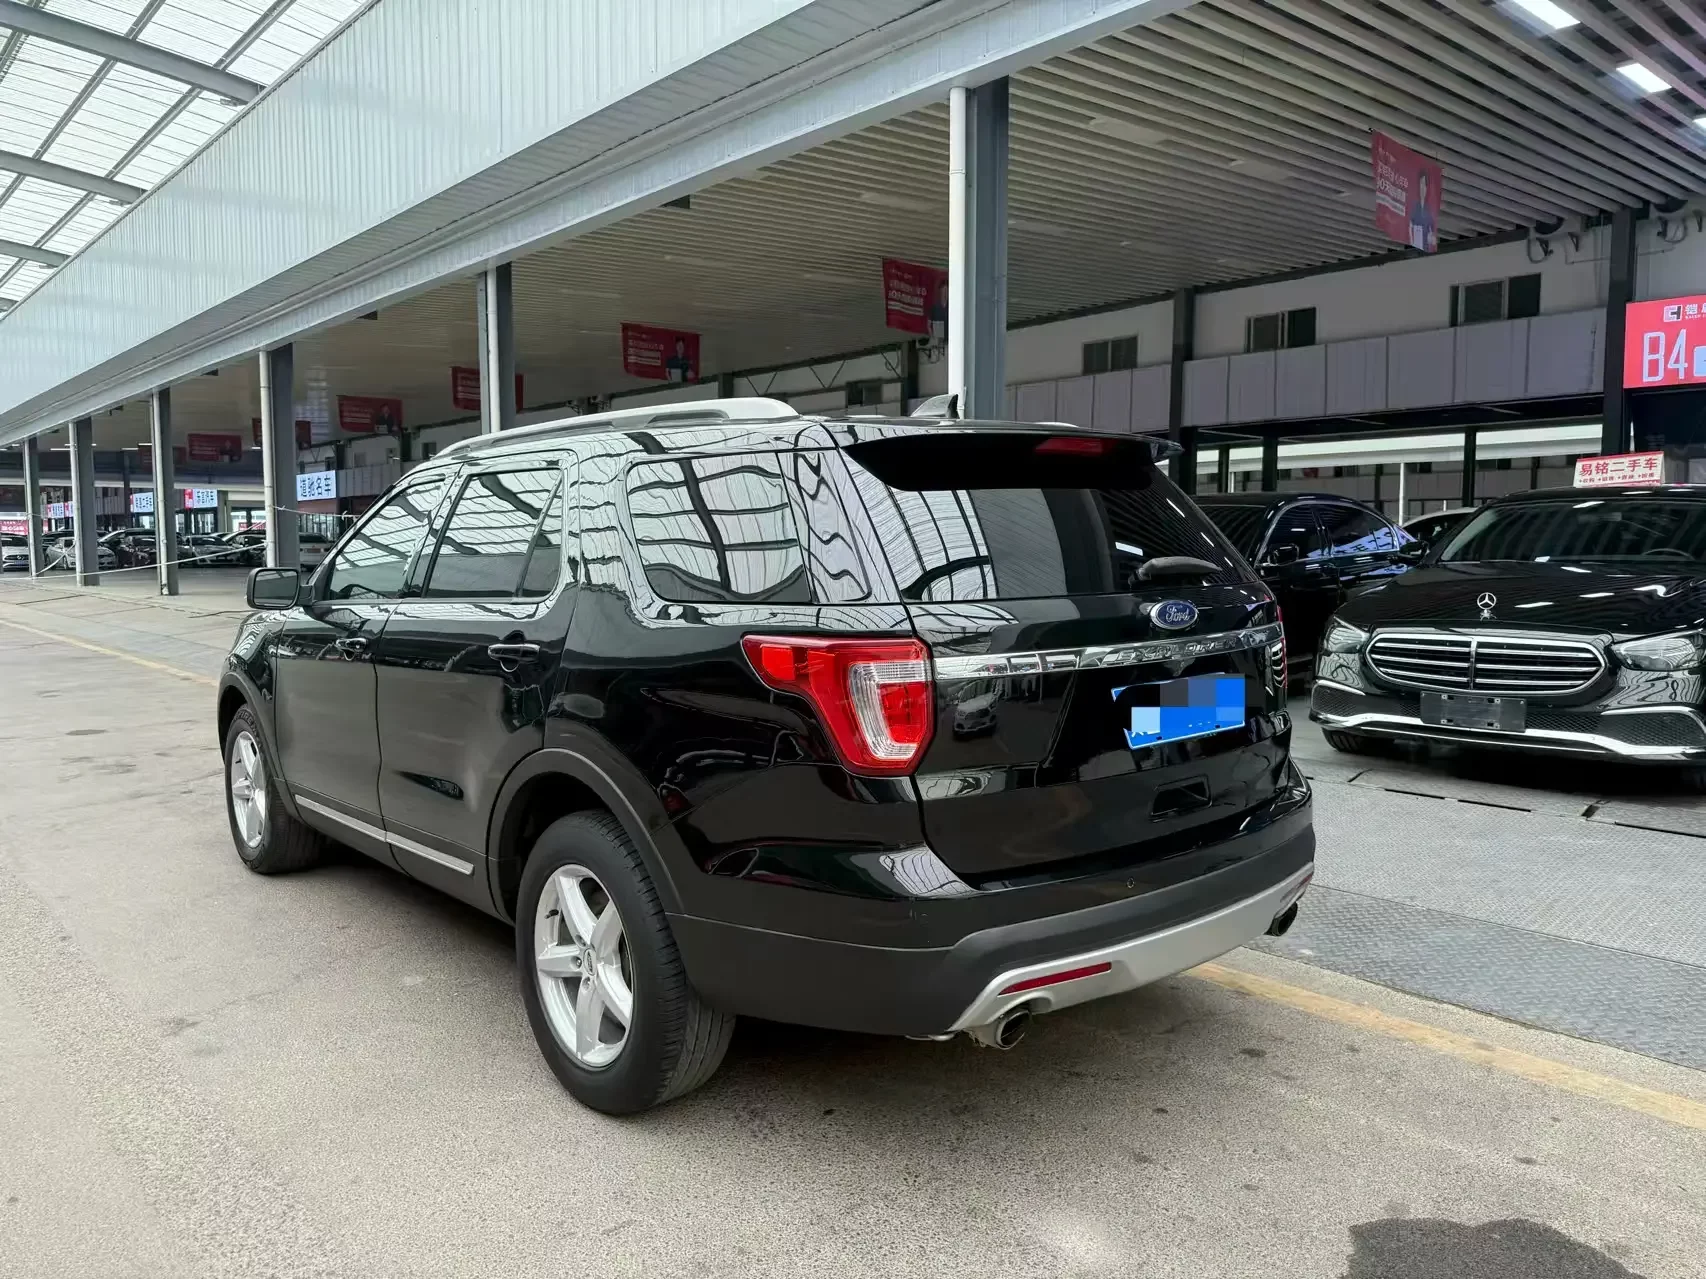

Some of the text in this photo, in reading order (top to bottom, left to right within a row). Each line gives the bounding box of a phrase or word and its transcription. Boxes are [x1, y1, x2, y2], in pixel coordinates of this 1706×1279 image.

[1580, 458, 1658, 476] 易铭二手车
[1165, 604, 1191, 622] Ford
[1116, 637, 1238, 662] EXPLORER
